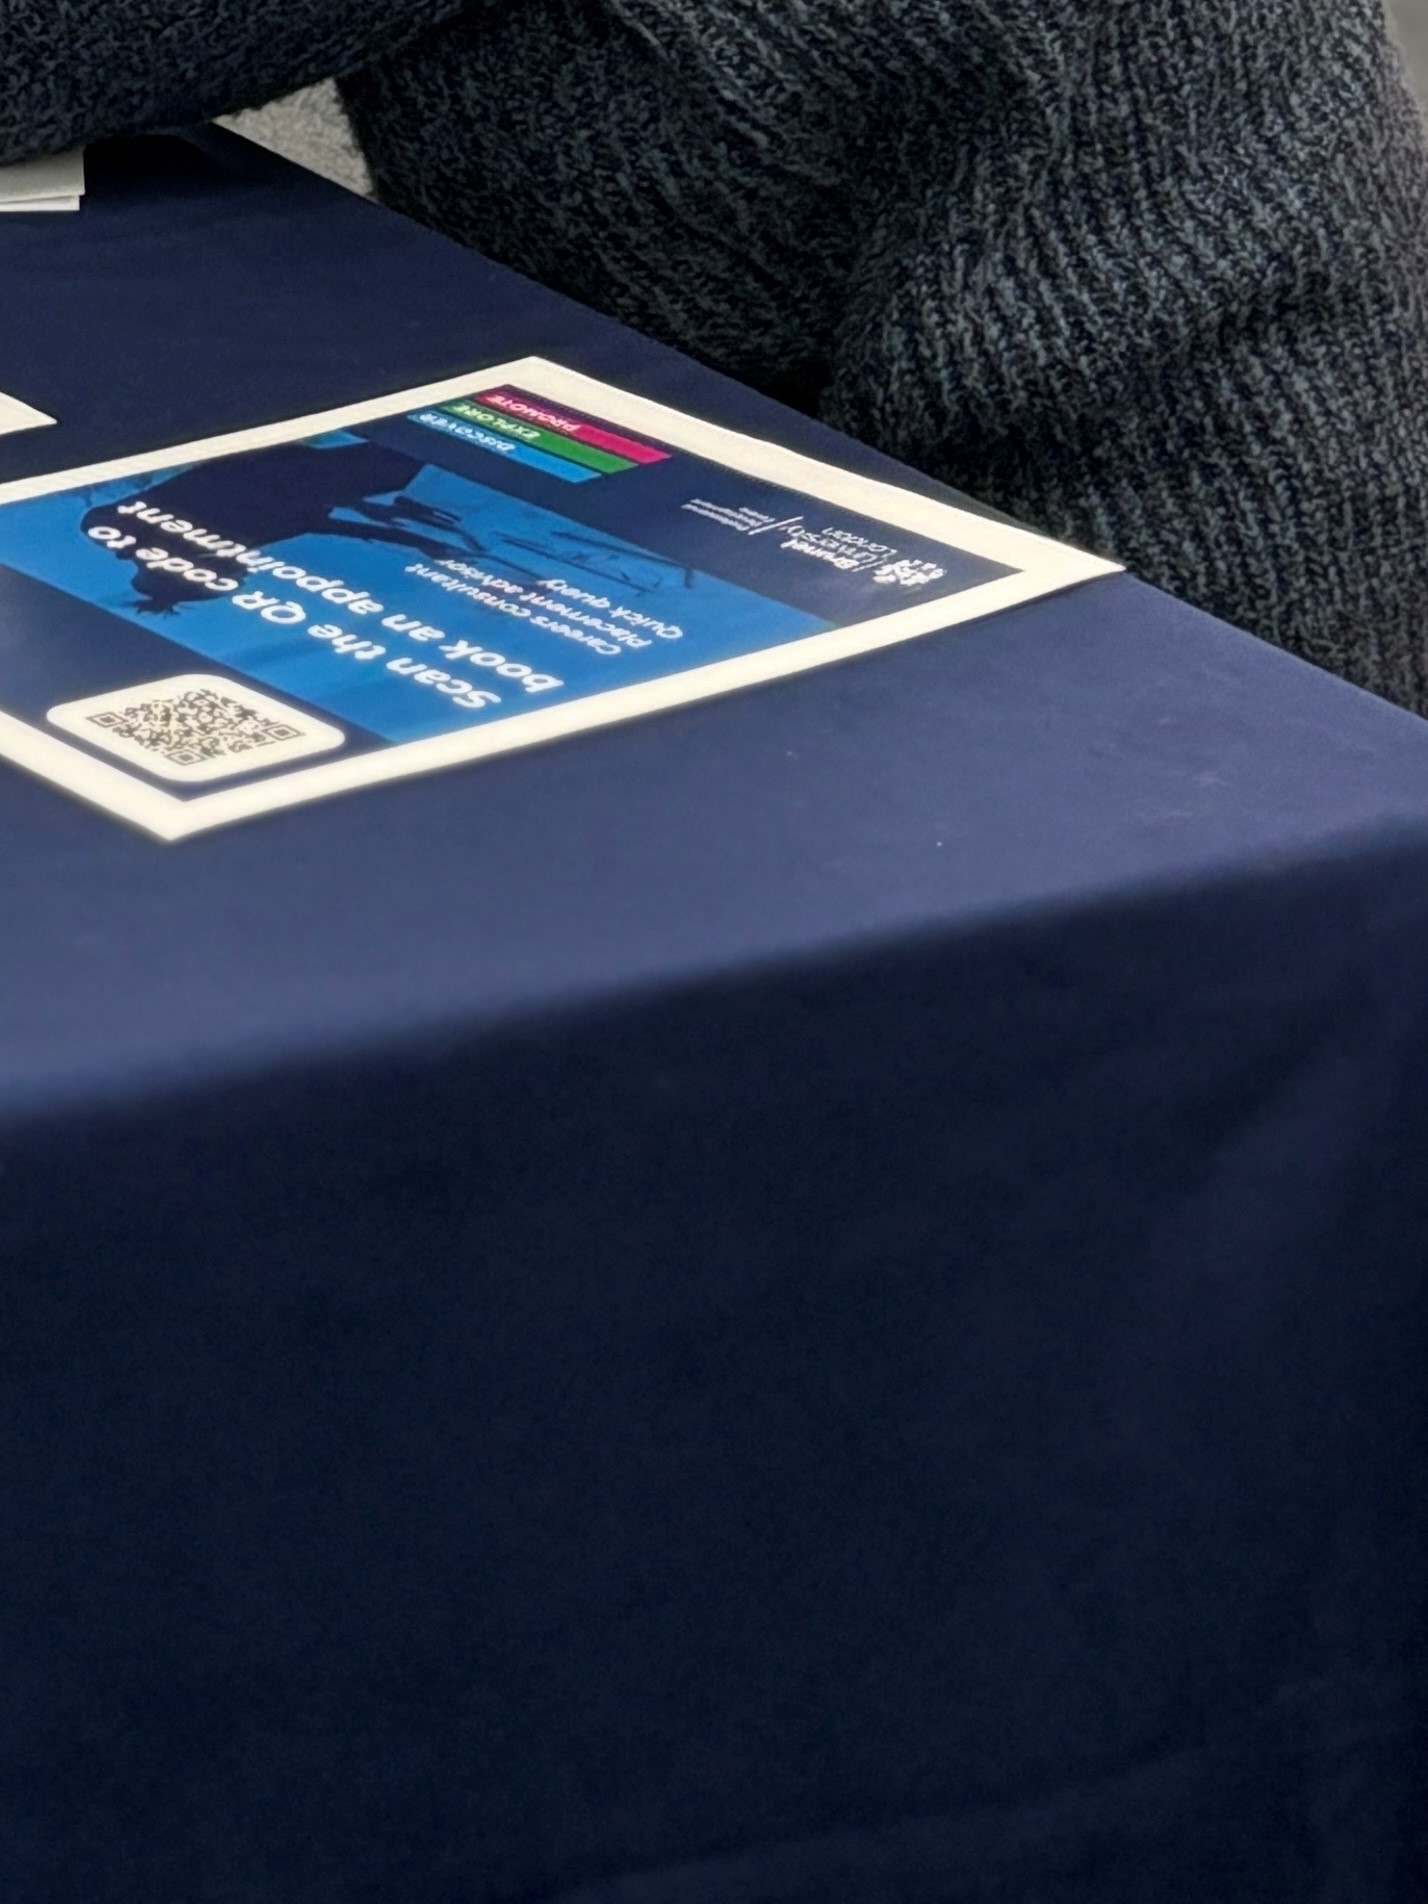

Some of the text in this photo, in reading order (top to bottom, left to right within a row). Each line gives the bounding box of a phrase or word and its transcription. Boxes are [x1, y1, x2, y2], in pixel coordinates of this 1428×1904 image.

[419, 413, 516, 451] DISCOVER
[454, 404, 541, 440] EXPLORE
[486, 395, 581, 432] PROMOTE
[778, 525, 878, 563] University
[780, 539, 860, 570] Brunel
[822, 527, 898, 558] London
[117, 500, 564, 693] book an appointment
[405, 563, 621, 655] Careers consultant
[434, 559, 652, 648] Placement advisor
[537, 579, 683, 639] Quick query
[87, 525, 501, 709] Scan the QR code to
